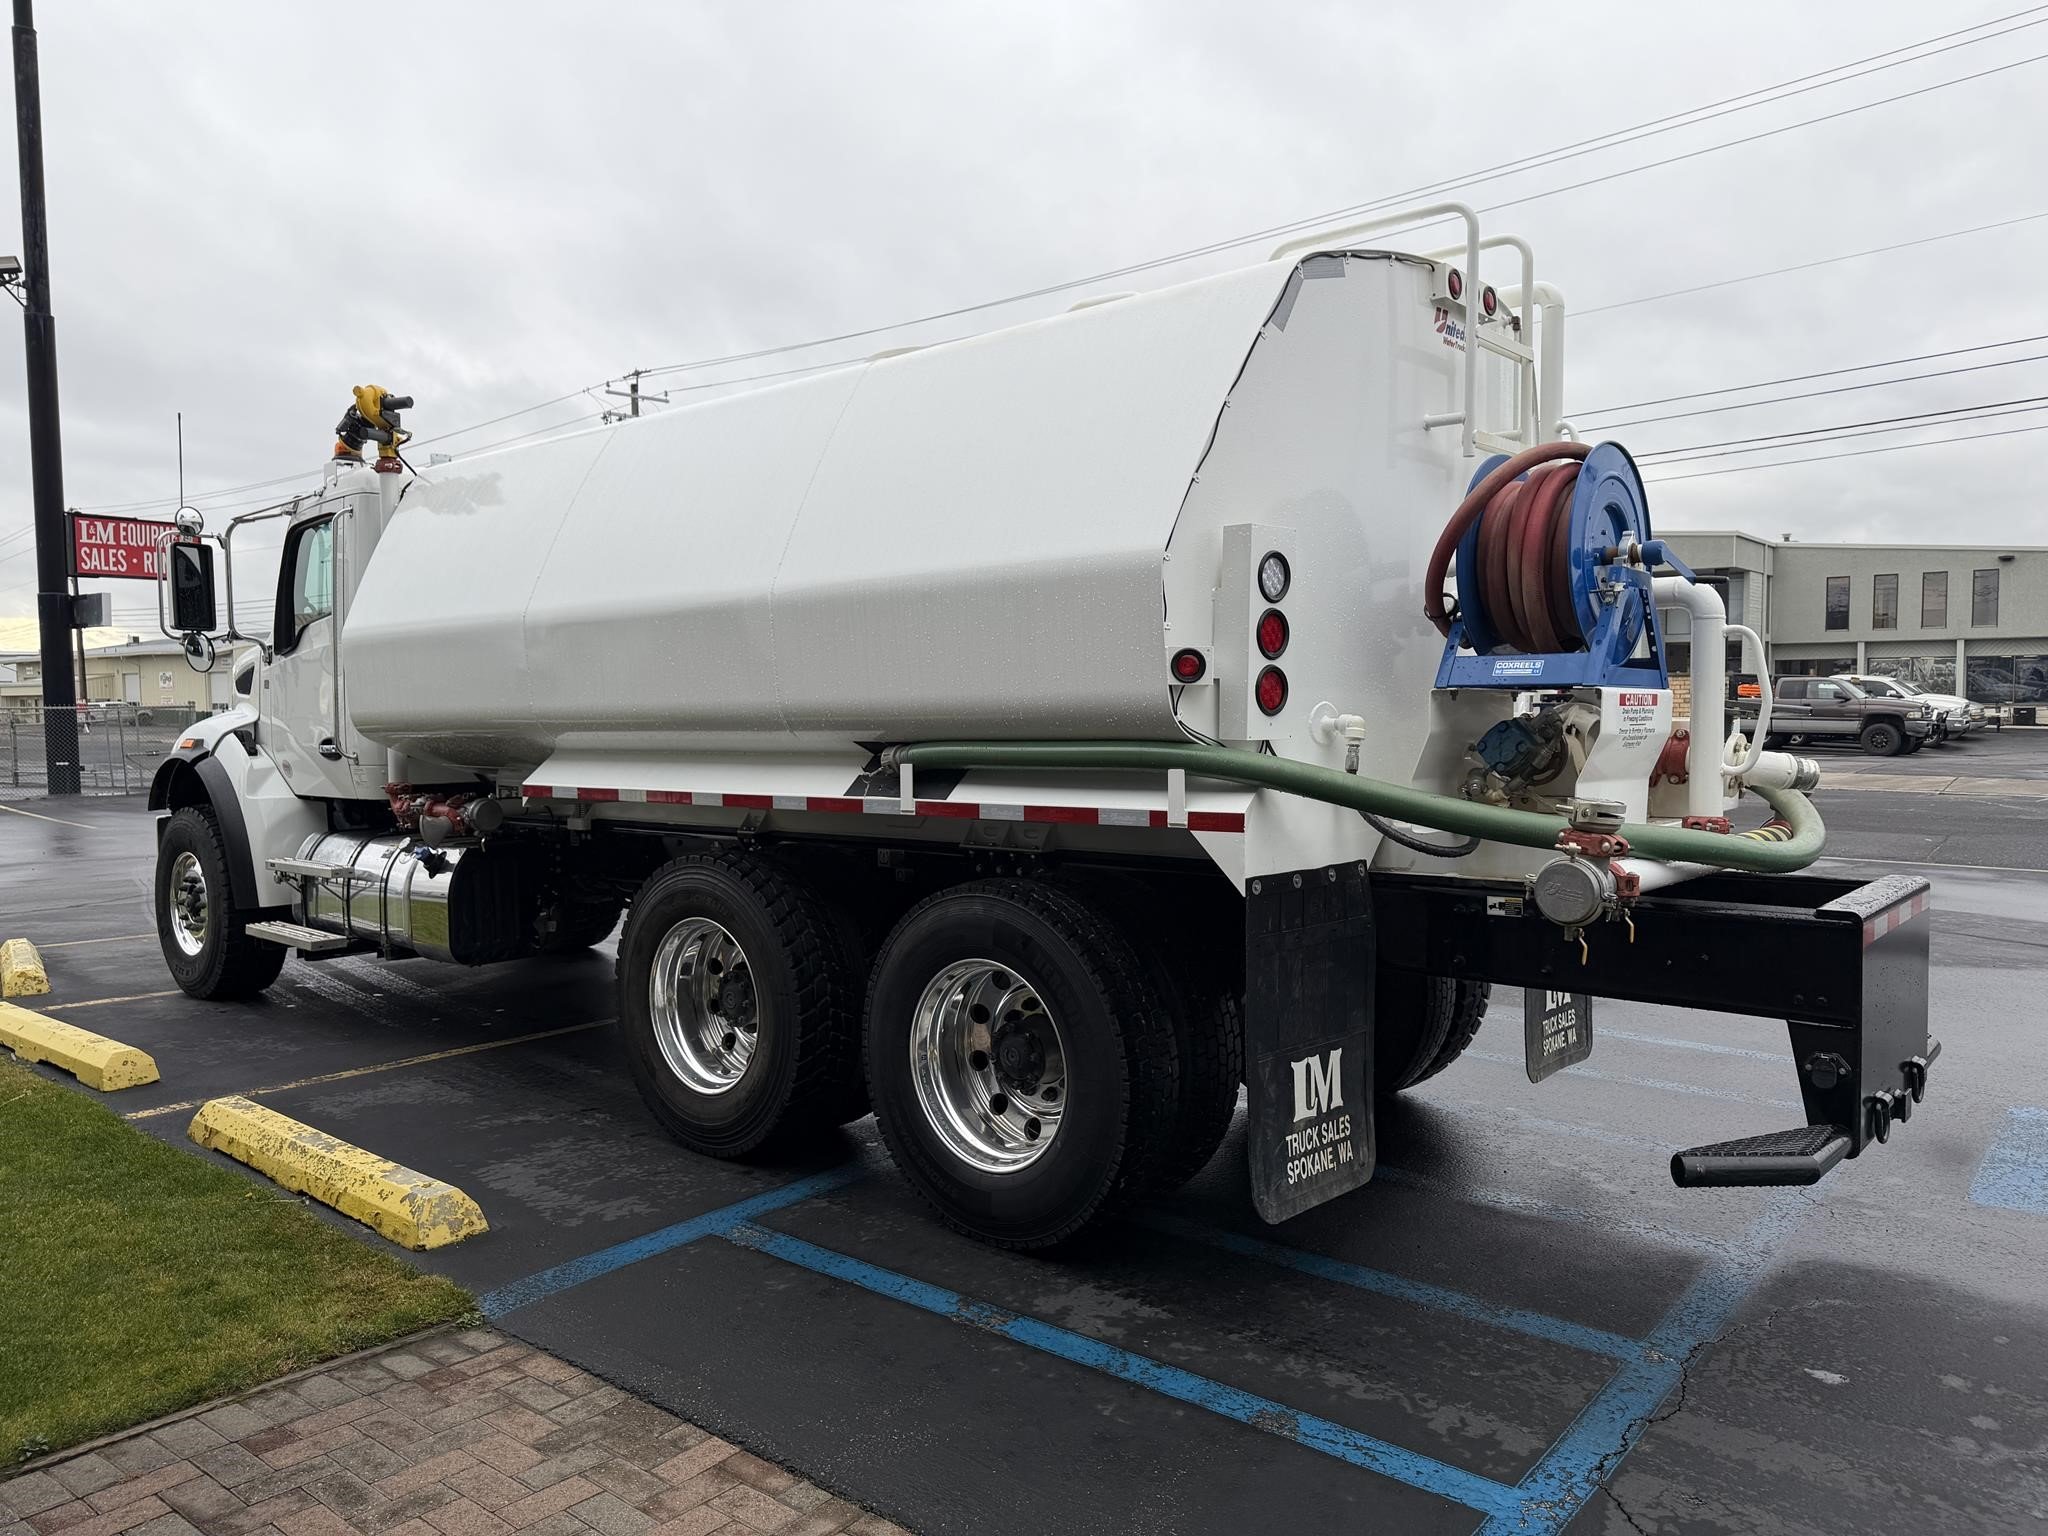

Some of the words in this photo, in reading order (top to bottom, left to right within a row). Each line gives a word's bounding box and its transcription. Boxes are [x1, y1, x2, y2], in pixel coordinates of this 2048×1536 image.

[79, 520, 117, 545] L&M
[81, 547, 127, 573] SALES
[1496, 661, 1541, 669] COXREELS
[1625, 694, 1653, 706] CAUTION
[1542, 1014, 1558, 1037] TRUCK
[1558, 1008, 1576, 1029] SALES
[1566, 1027, 1577, 1045] WA
[1285, 1125, 1323, 1158] TRUCK
[1321, 1114, 1351, 1144] SALES
[1287, 1147, 1338, 1185] SPOKANE,
[1337, 1140, 1354, 1165] WA
